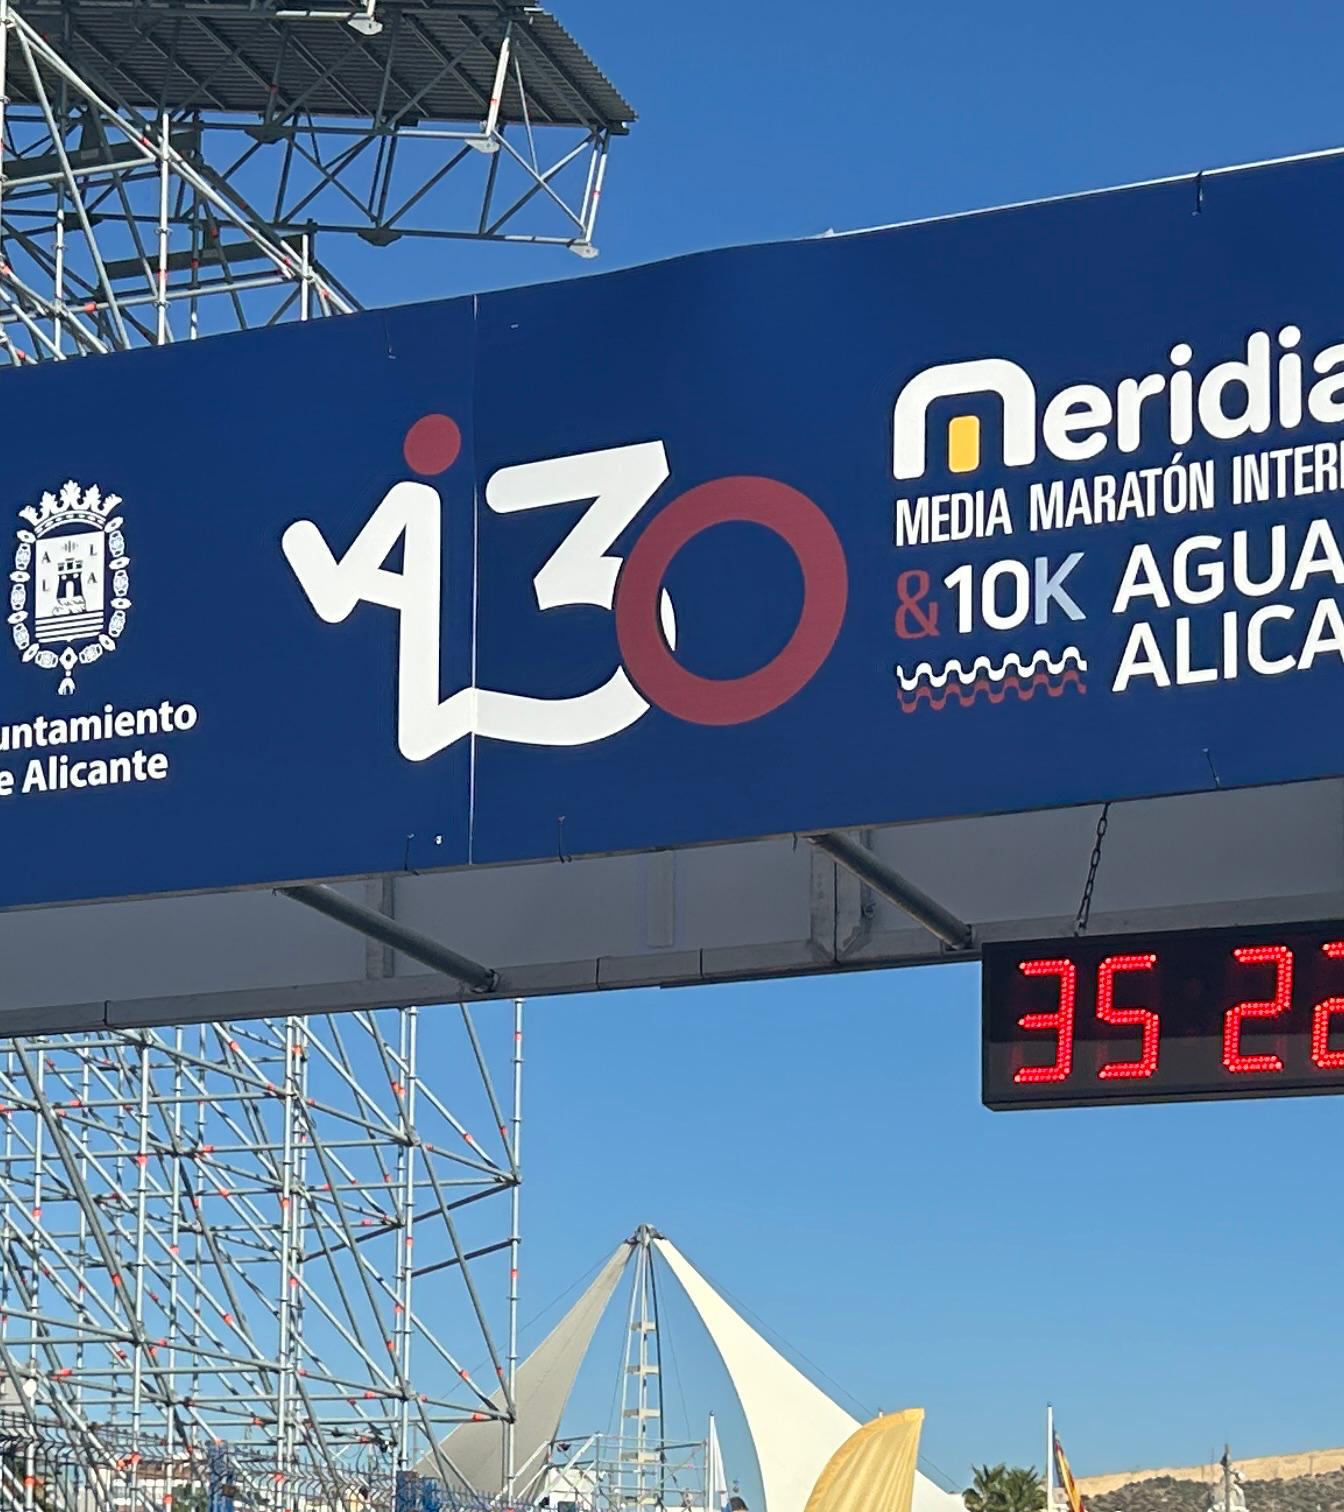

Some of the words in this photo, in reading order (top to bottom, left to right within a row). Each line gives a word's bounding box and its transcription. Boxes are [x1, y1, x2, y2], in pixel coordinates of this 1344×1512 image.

[895, 487, 1013, 547] MEDIA
[1029, 453, 1215, 533] MARATÓN
[21, 748, 169, 796] Alicante
[1013, 953, 1161, 1085] 35
